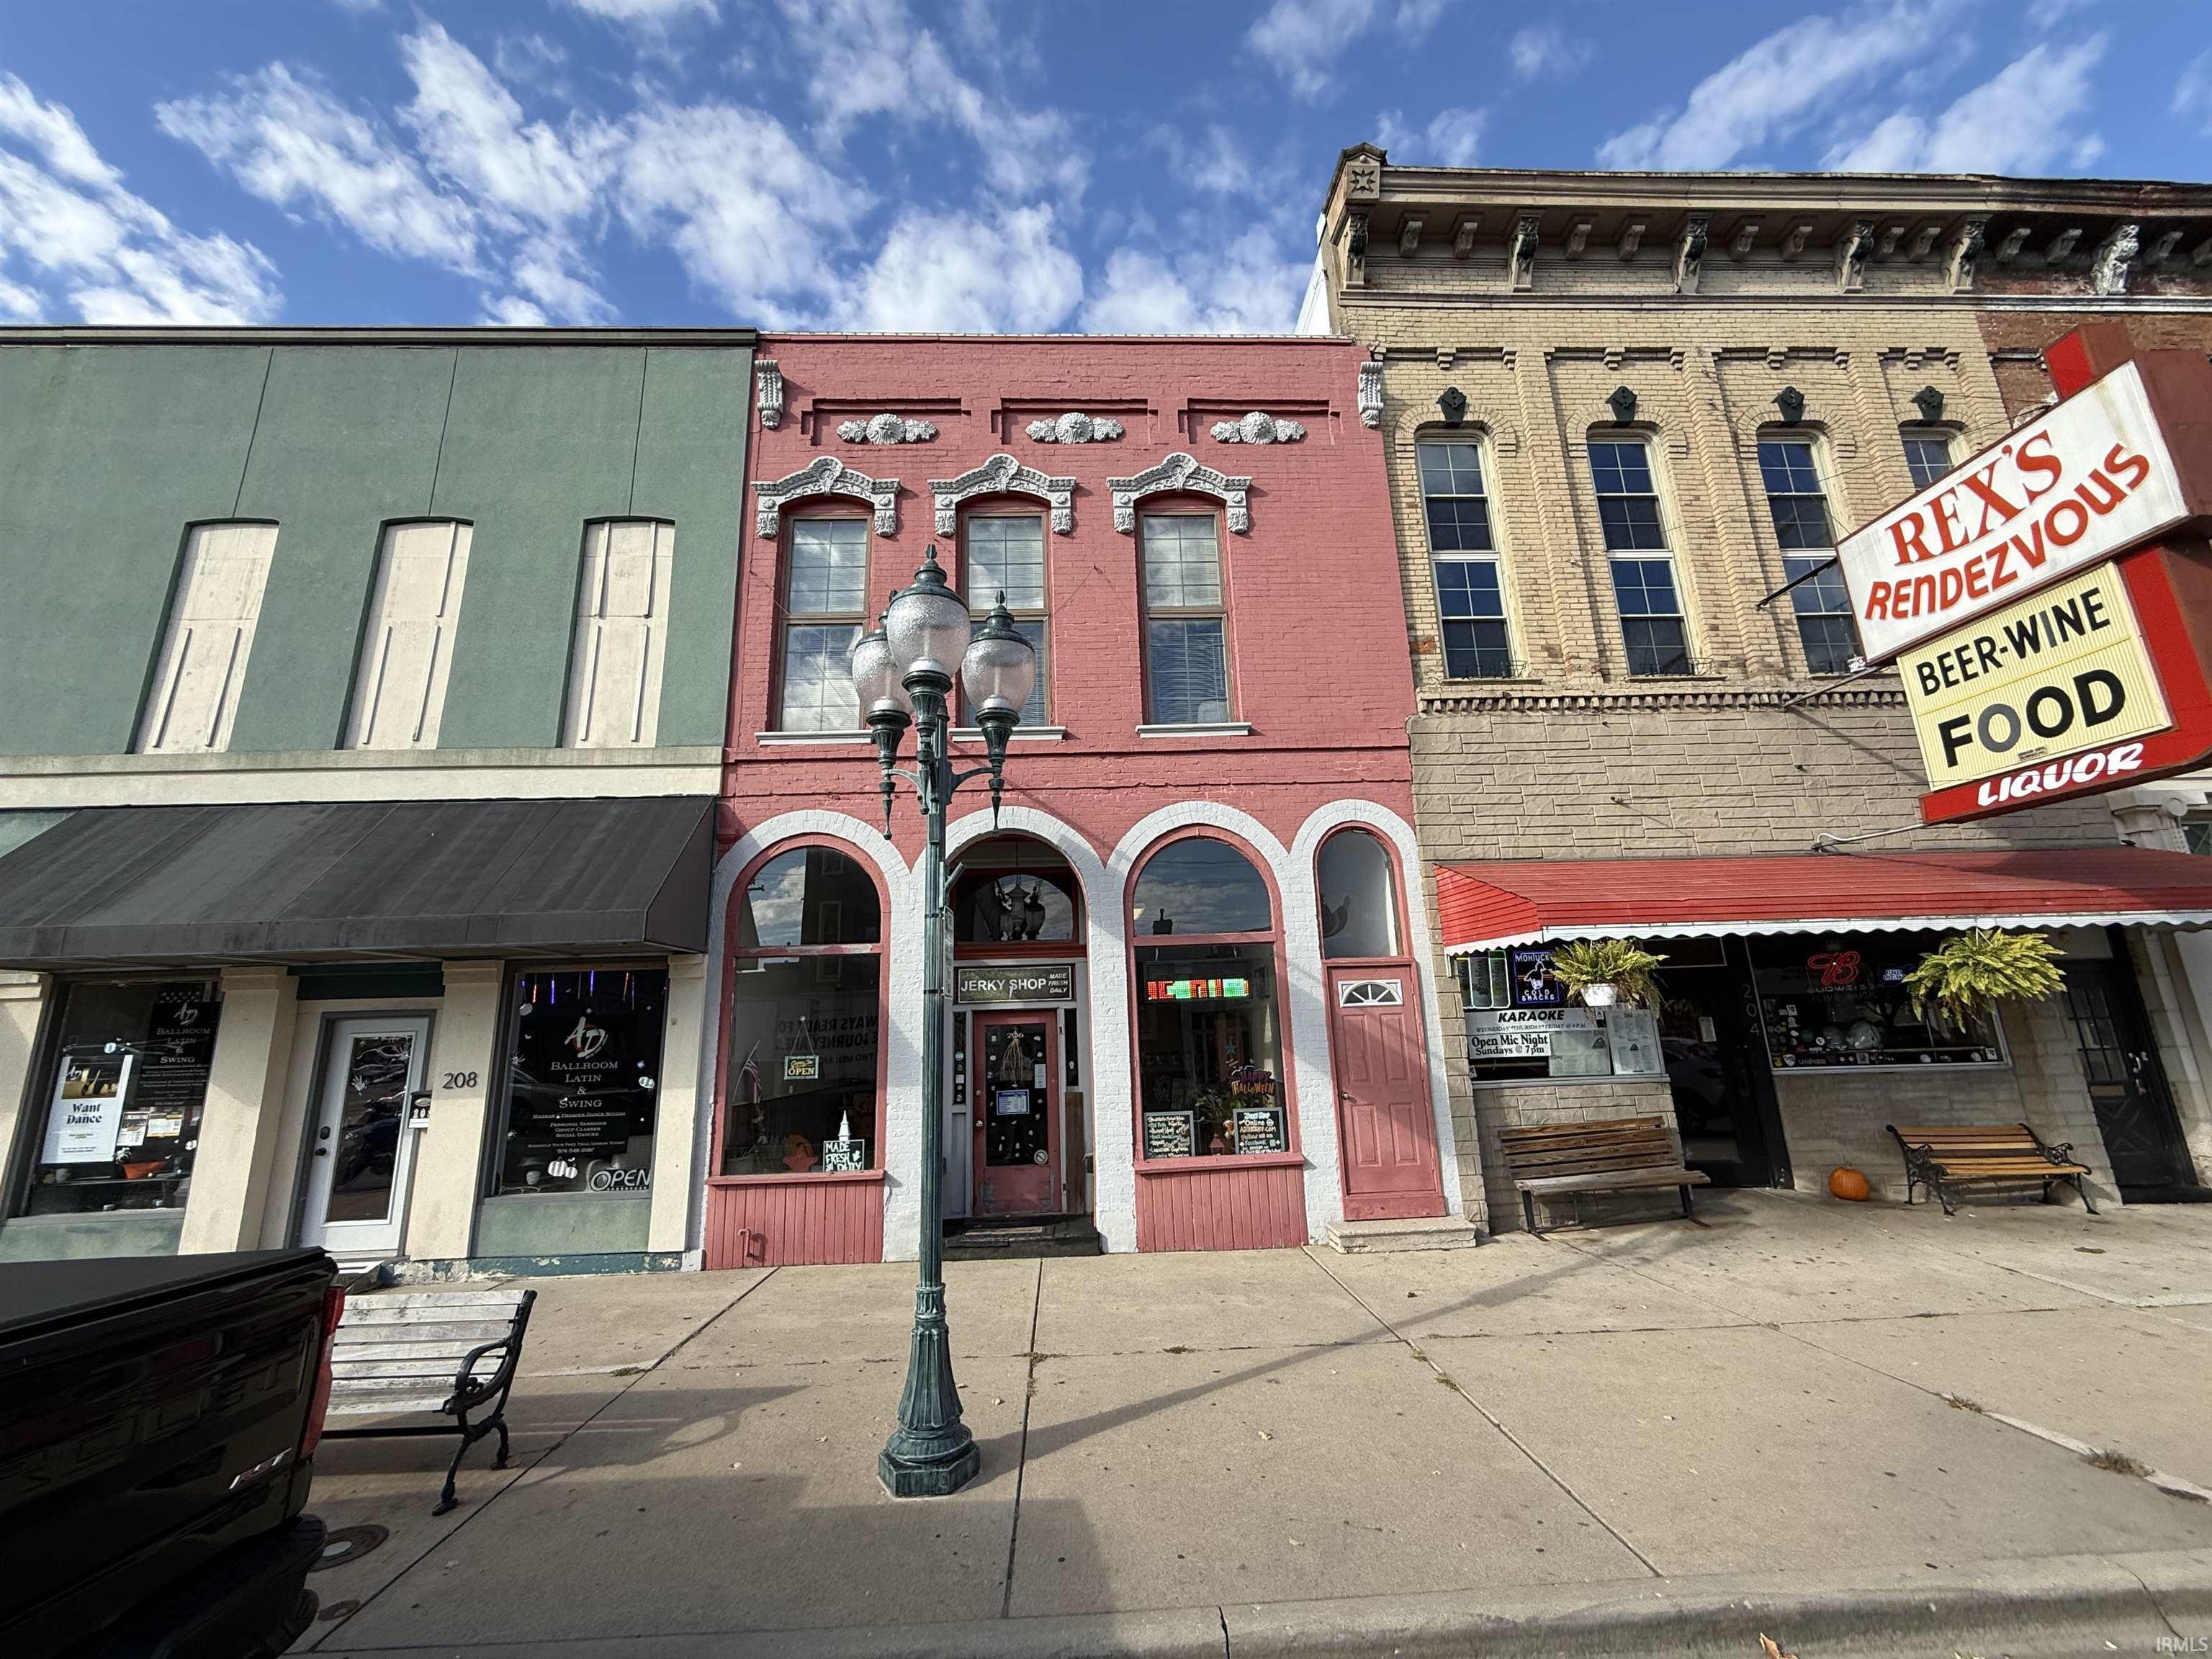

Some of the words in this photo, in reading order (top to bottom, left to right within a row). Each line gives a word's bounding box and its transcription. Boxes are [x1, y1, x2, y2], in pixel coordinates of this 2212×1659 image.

[1886, 430, 2062, 567] REX'S
[1866, 443, 2150, 620] RENDEZVOUS
[1917, 587, 2110, 696] BEER-WINE
[1938, 669, 2126, 768] FOOD
[1978, 742, 2144, 807] LIQUOR
[961, 979, 1006, 992] JERKY
[1009, 979, 1046, 991] SHOP
[1498, 1010, 1565, 1023] KARAOKE
[1472, 1035, 1498, 1049] Open
[1501, 1035, 1519, 1045] Mic
[1521, 1034, 1548, 1048] Night
[1476, 1046, 1513, 1056] Sundays
[1525, 1045, 1545, 1055] 7pm
[550, 1061, 619, 1071] BALLROOM
[788, 1067, 814, 1076] OPEN
[442, 1071, 477, 1089] 208
[565, 1074, 603, 1082] LATIN
[577, 1086, 588, 1094] &
[73, 1103, 102, 1112] Want
[559, 1099, 603, 1108] SWING
[66, 1115, 103, 1124] Dance
[825, 1141, 850, 1153] MADE
[825, 1152, 850, 1165] FRESH
[590, 1169, 651, 1192] OPEN
